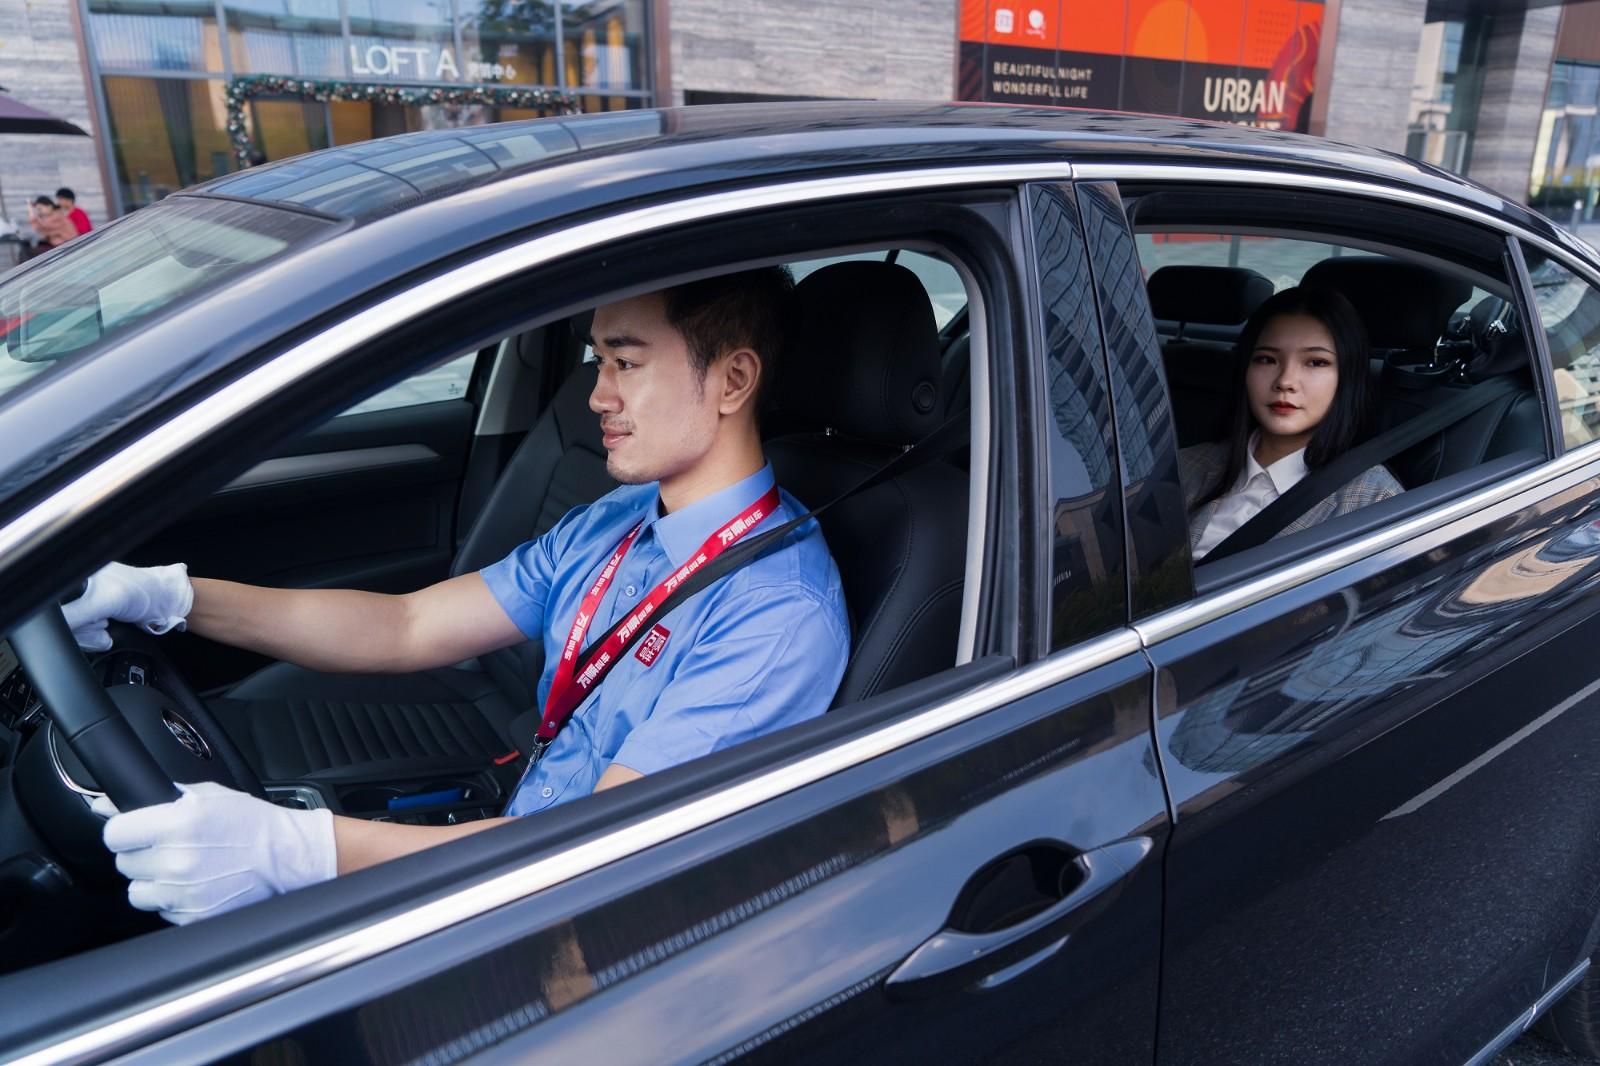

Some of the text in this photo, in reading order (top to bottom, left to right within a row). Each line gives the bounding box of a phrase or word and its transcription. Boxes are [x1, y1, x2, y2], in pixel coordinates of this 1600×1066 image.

[350, 44, 460, 80] LOFT A
[993, 61, 1093, 81] BEAUTIFUL NIGHT
[1063, 85, 1088, 99] LIFE
[1203, 77, 1286, 113] URBAN
[717, 509, 764, 546] 万顺叫车
[664, 553, 708, 594] 万顺叫车
[617, 602, 654, 644] 万顺叫车
[576, 652, 611, 689] 万顺叫车
